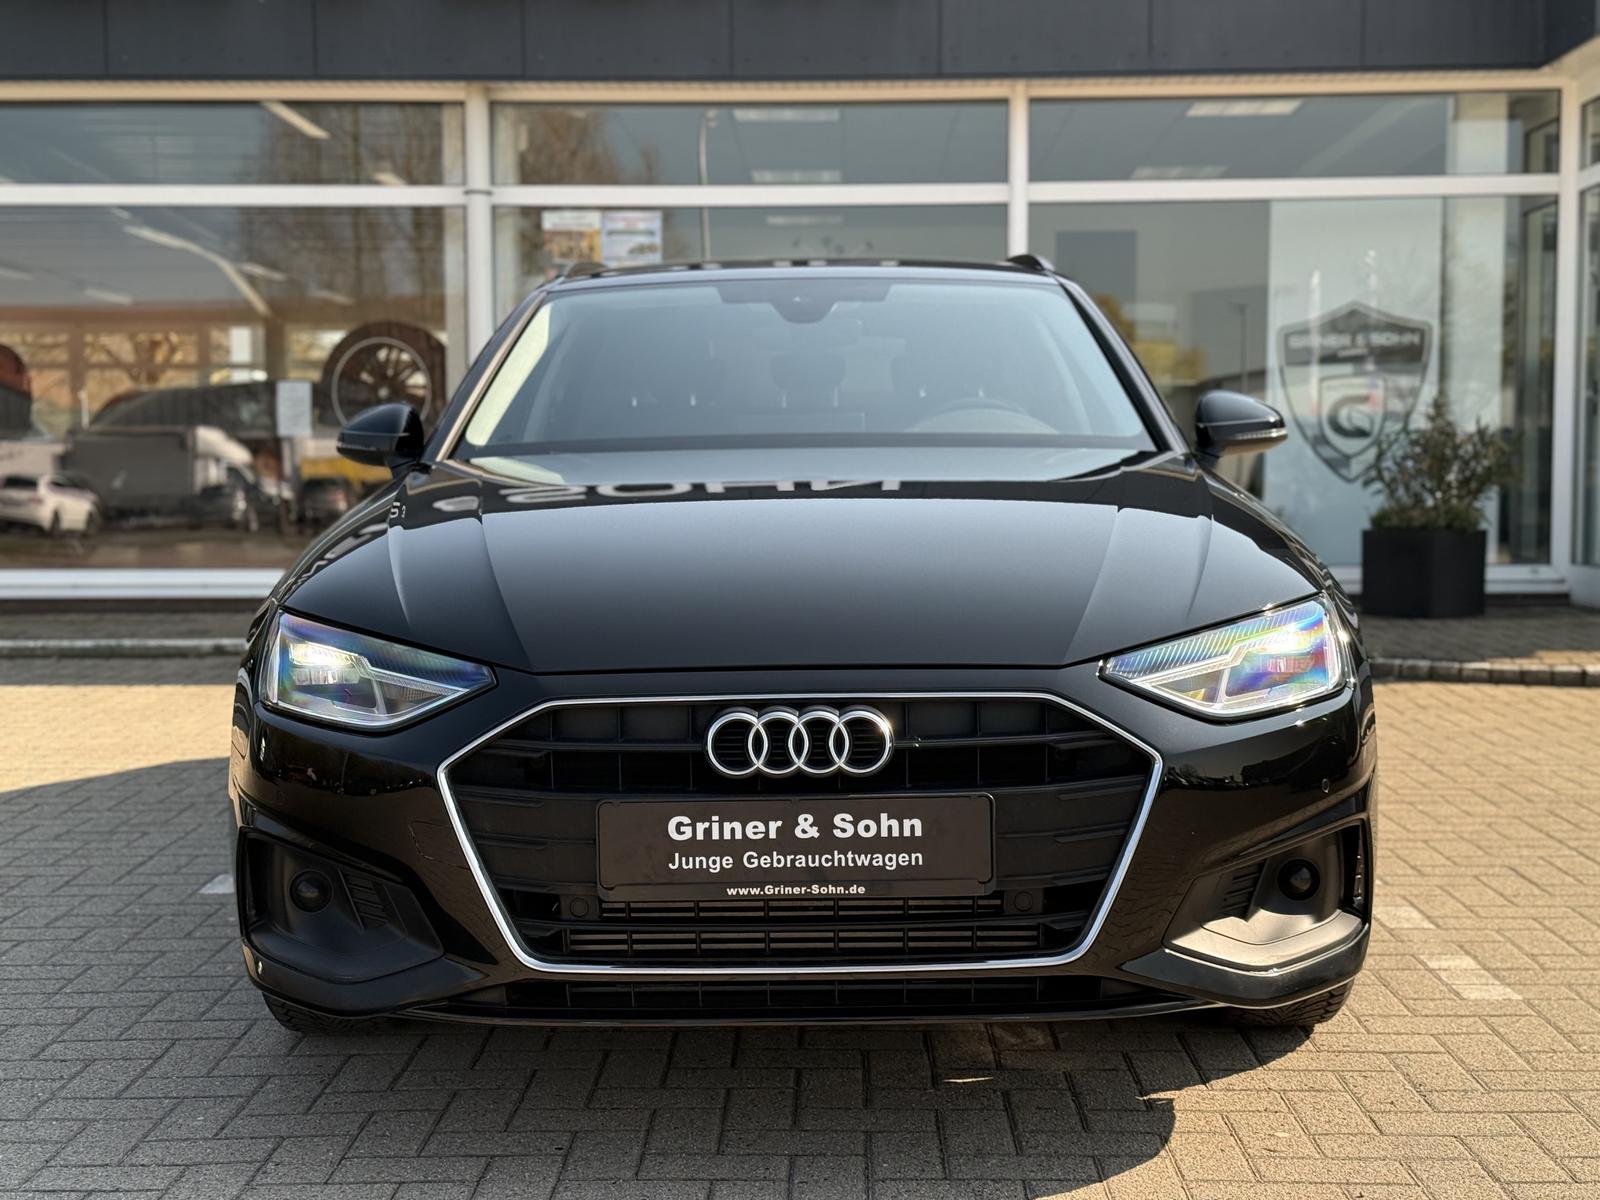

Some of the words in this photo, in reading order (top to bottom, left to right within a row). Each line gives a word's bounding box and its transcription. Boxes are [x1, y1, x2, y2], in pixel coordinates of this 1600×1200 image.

[667, 815, 783, 841] Griner
[794, 813, 821, 840] &
[832, 812, 924, 839] Sohn
[668, 852, 734, 874] Junge
[742, 849, 924, 871] Gebrauchtwagen
[726, 884, 866, 897] www.Griner-Sohn.de
